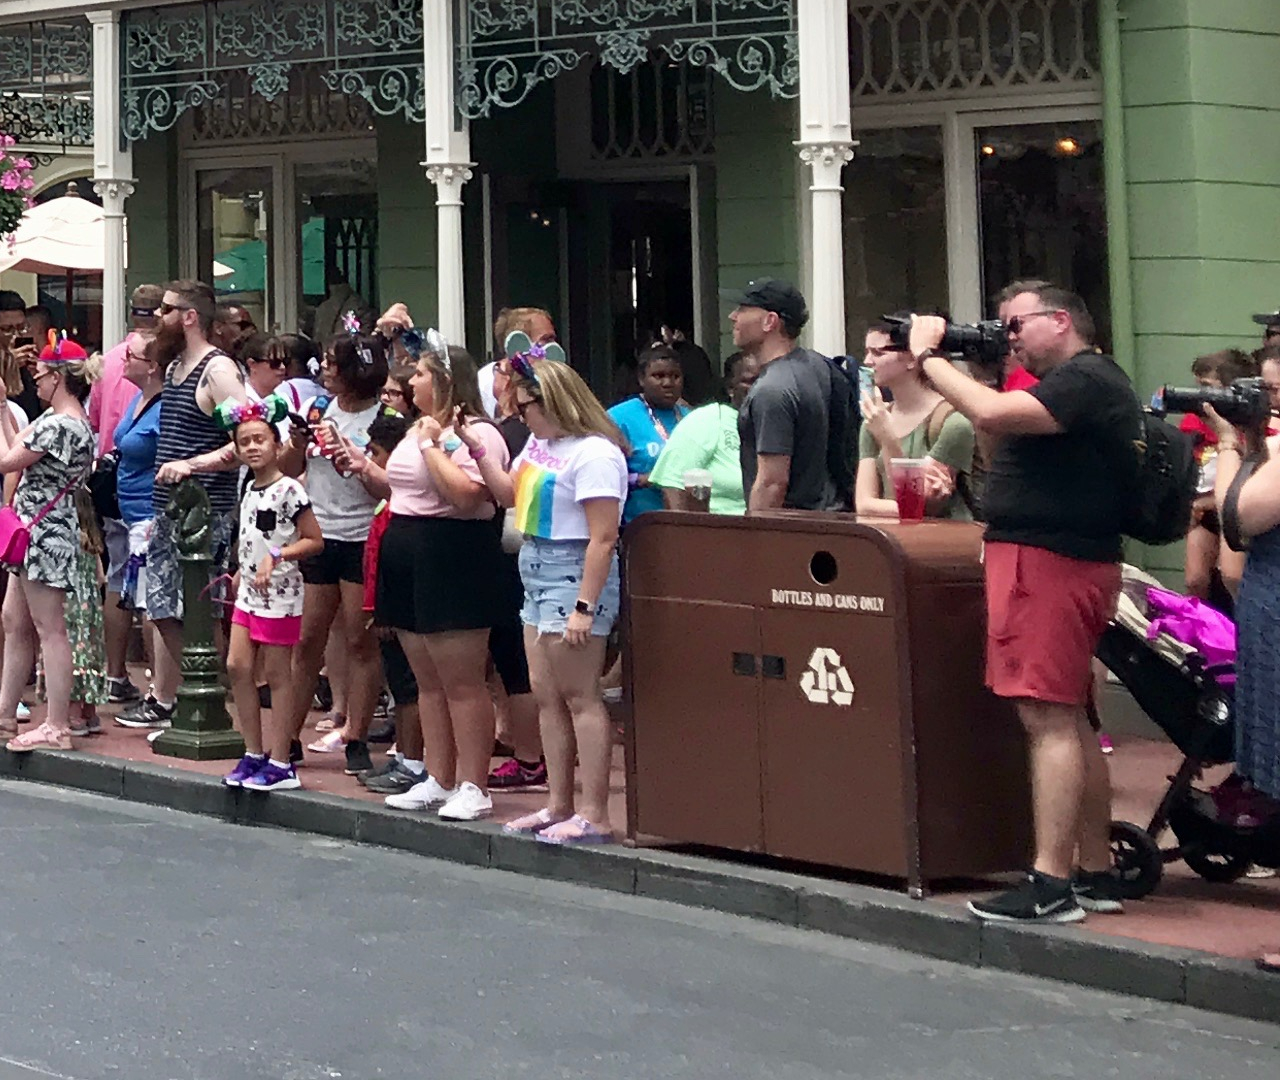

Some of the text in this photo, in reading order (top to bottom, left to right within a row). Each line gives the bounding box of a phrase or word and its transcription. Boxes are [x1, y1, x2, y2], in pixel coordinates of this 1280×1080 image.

[771, 589, 885, 612] BOTTLES AND CANS ONLY
